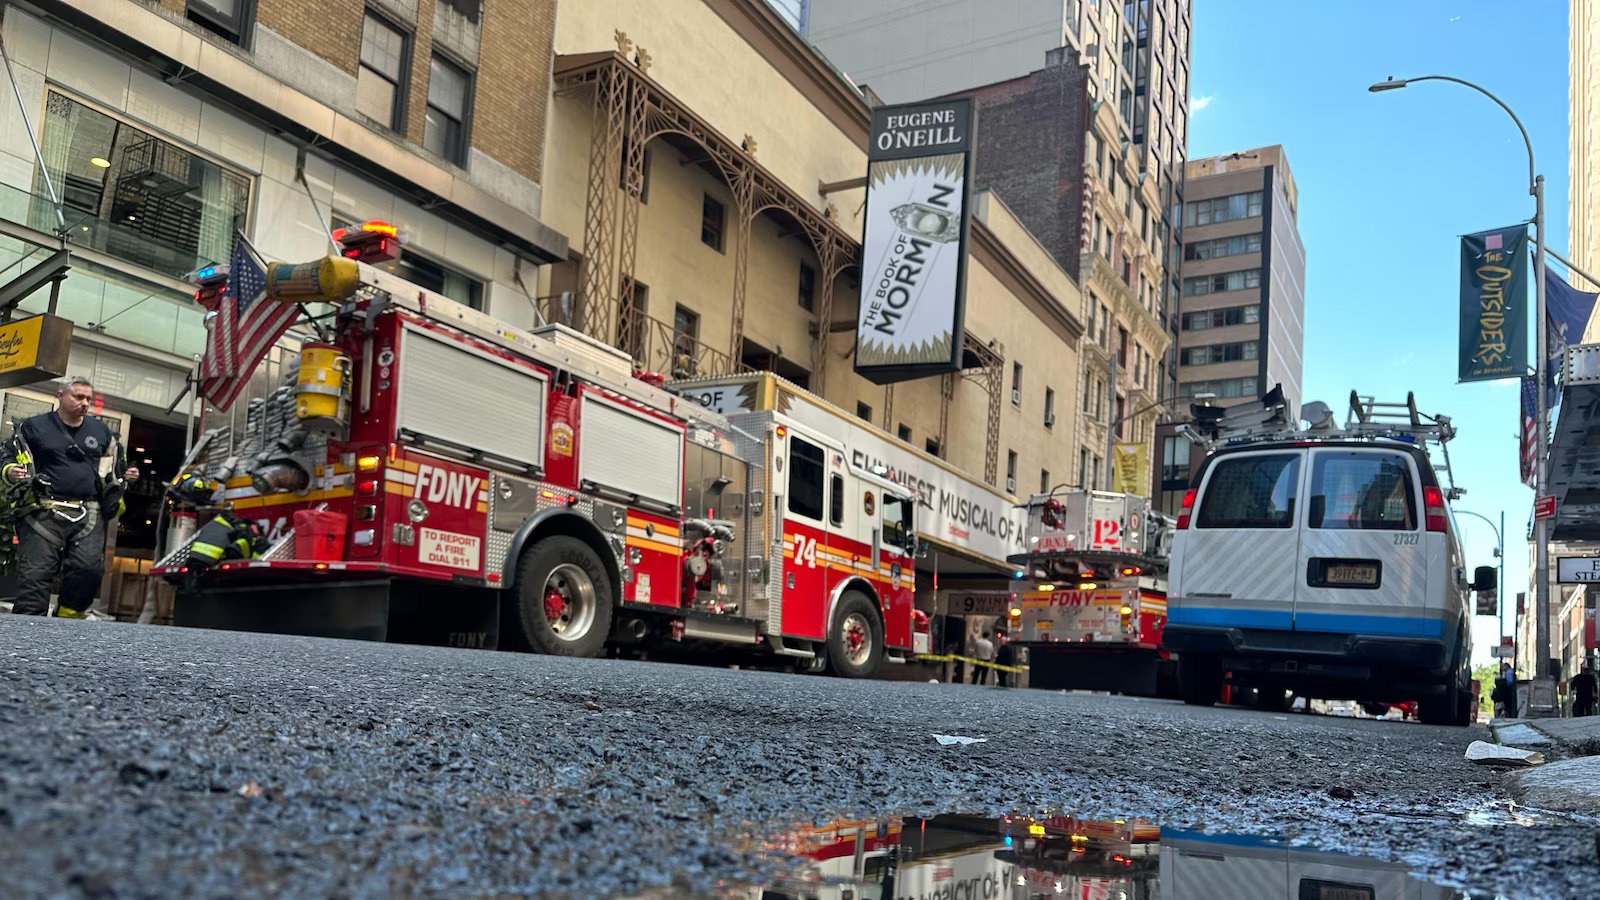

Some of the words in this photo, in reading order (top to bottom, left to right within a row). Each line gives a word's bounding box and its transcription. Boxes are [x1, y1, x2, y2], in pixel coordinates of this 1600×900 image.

[887, 110, 955, 129] EUGENE
[878, 126, 962, 151] O'NEILL
[1484, 252, 1503, 263] THE
[863, 301, 882, 327] THE
[876, 258, 900, 299] BOOK
[894, 234, 908, 254] OF
[1476, 265, 1512, 366] OUTSIDERS
[700, 391, 724, 407] OF
[414, 463, 481, 510] FDNY
[939, 489, 996, 536] MUSICAL
[998, 516, 1014, 542] OF
[424, 530, 437, 540] TO
[439, 532, 476, 547] REPORT
[1093, 519, 1119, 545] 12
[1393, 533, 1419, 545] 27327
[435, 543, 442, 552] A
[445, 544, 465, 556] FIRE
[794, 533, 817, 569] 74
[428, 553, 450, 564] DIAL
[453, 556, 470, 567] 911
[964, 596, 975, 612] 9
[1049, 591, 1095, 607] FDNY
[449, 631, 486, 648] FDNY
